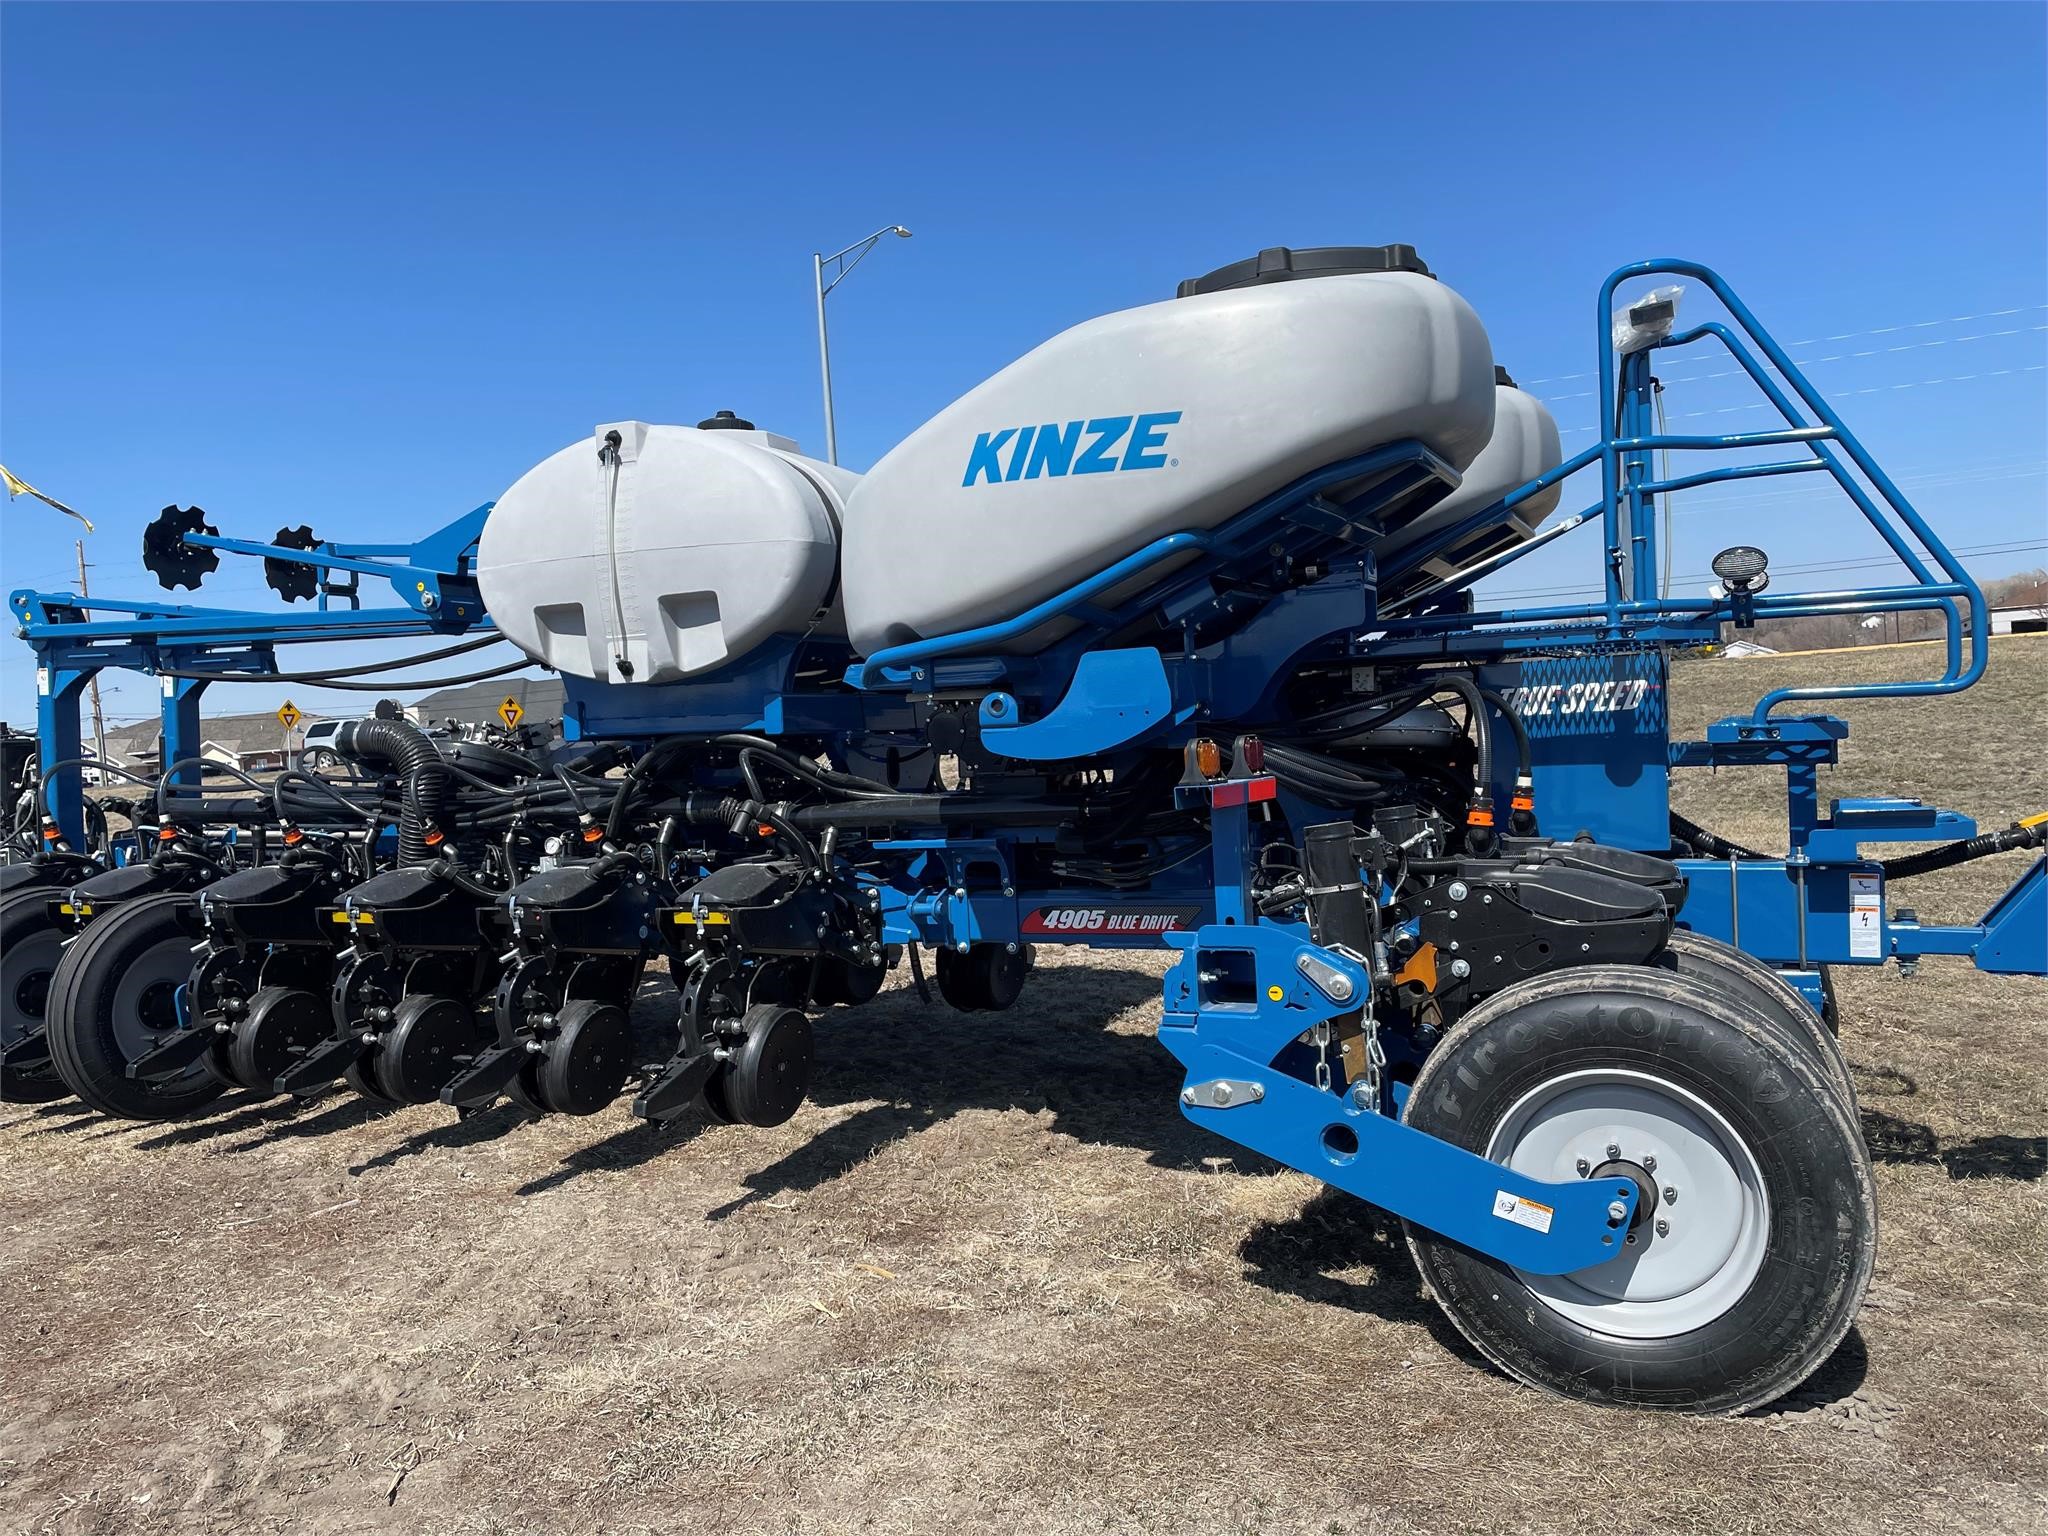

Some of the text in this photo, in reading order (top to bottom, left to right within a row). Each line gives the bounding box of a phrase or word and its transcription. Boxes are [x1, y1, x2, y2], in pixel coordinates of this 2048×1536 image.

[962, 411, 1183, 487] KINZE
[1495, 679, 1648, 717] TRUE SPEED
[1043, 909, 1179, 930] 4905 BLUE DRIVE
